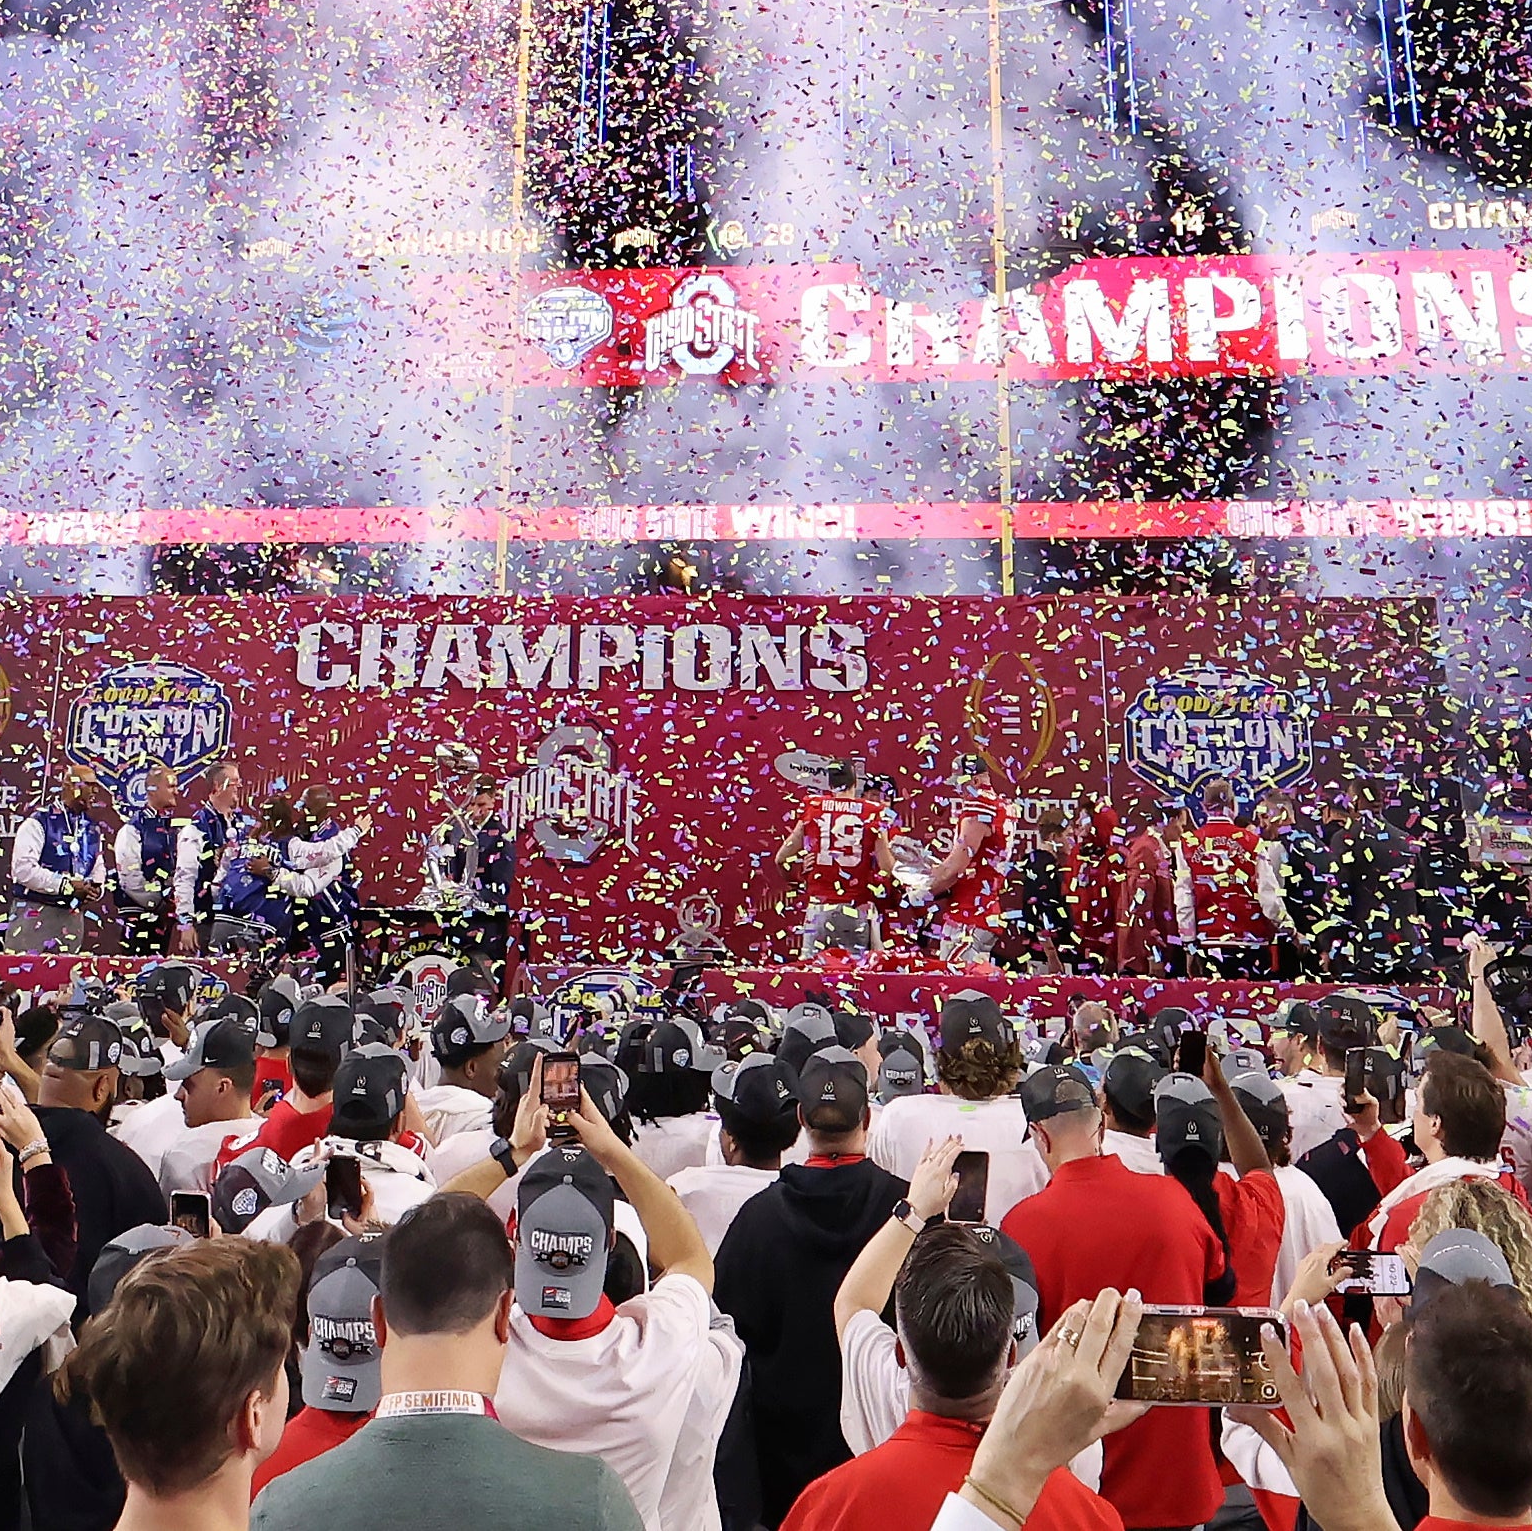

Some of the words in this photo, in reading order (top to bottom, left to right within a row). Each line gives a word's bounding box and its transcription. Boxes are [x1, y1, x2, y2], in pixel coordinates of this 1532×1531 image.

[763, 222, 795, 246] 28
[1172, 210, 1205, 237] 14
[730, 504, 858, 539] WINS!
[295, 622, 868, 692] CHAMPIONS
[530, 1230, 593, 1255] CHAMPS
[314, 1316, 376, 1343] CHAMPS
[405, 1392, 477, 1408] SEMIFINAL
